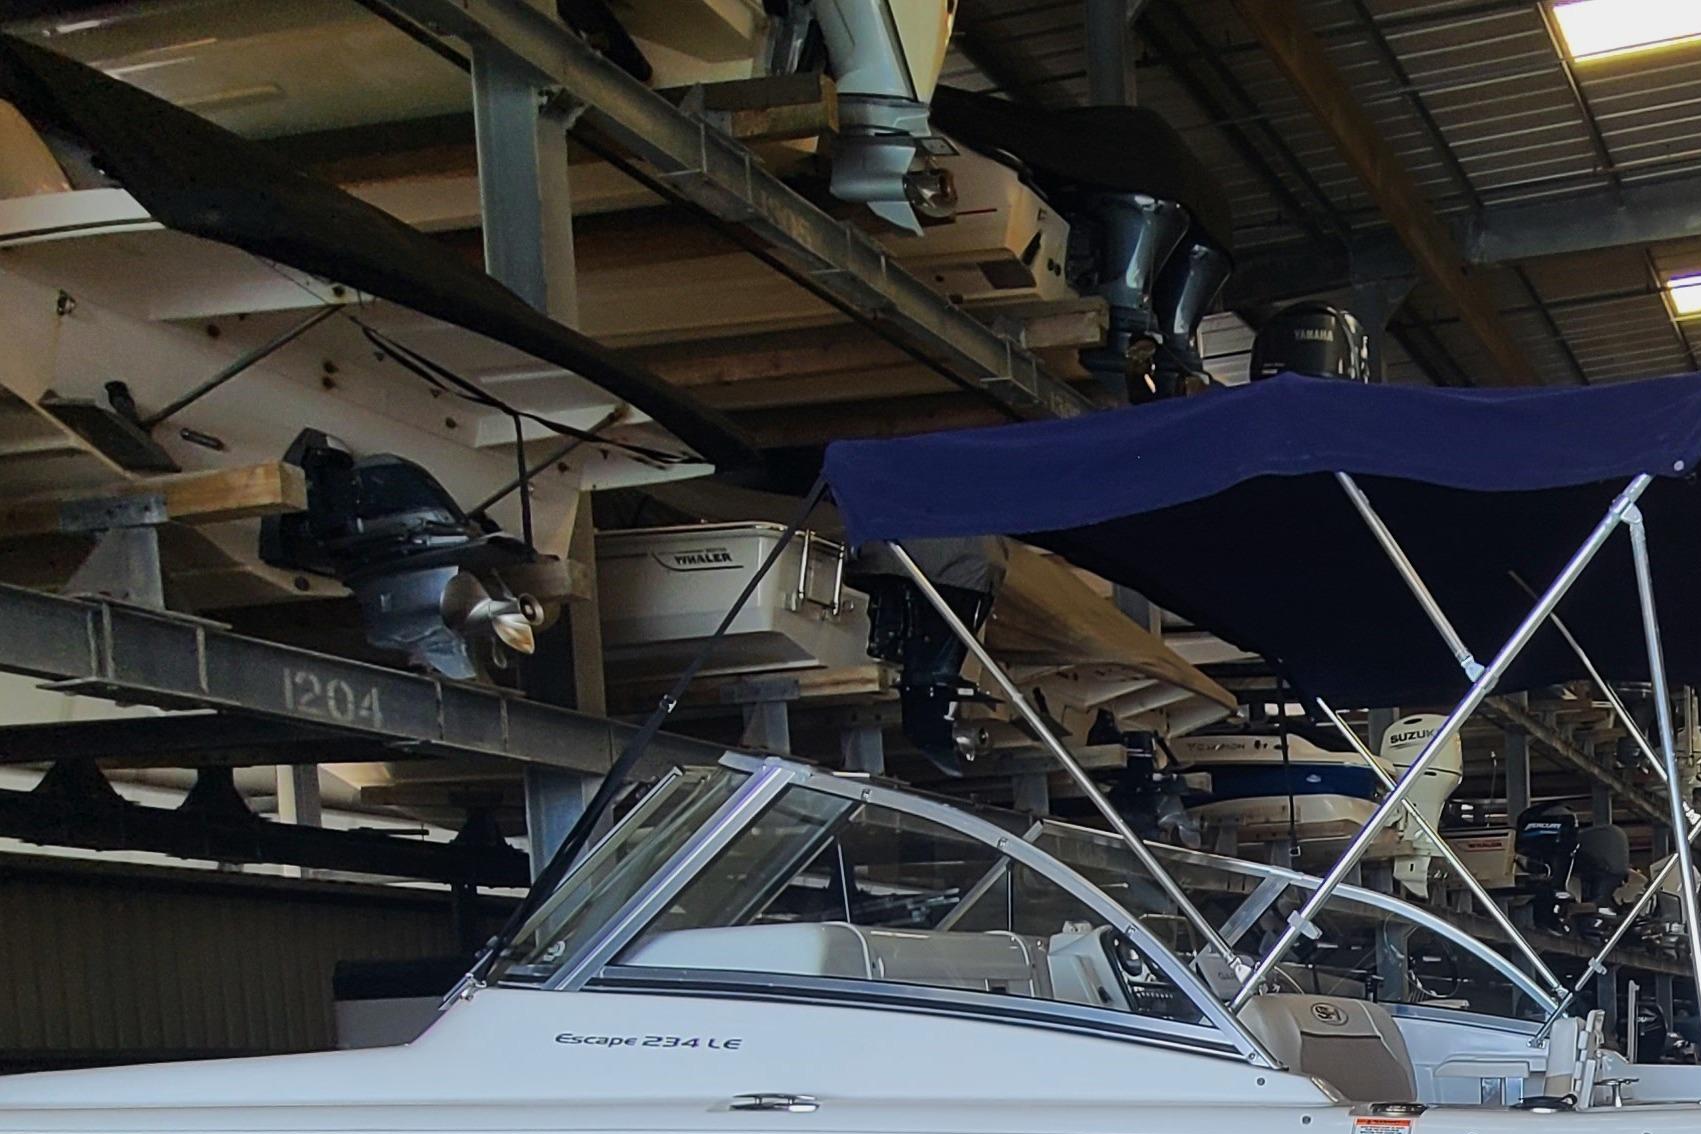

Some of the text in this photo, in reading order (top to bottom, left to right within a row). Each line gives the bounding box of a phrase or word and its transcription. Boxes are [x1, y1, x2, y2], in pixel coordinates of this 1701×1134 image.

[1294, 329, 1334, 342] YAMAHA
[674, 553, 732, 565] WHALER
[283, 667, 384, 729] 1204
[1390, 729, 1437, 744] SUZUK
[555, 1033, 743, 1050] Escape 234 LE
